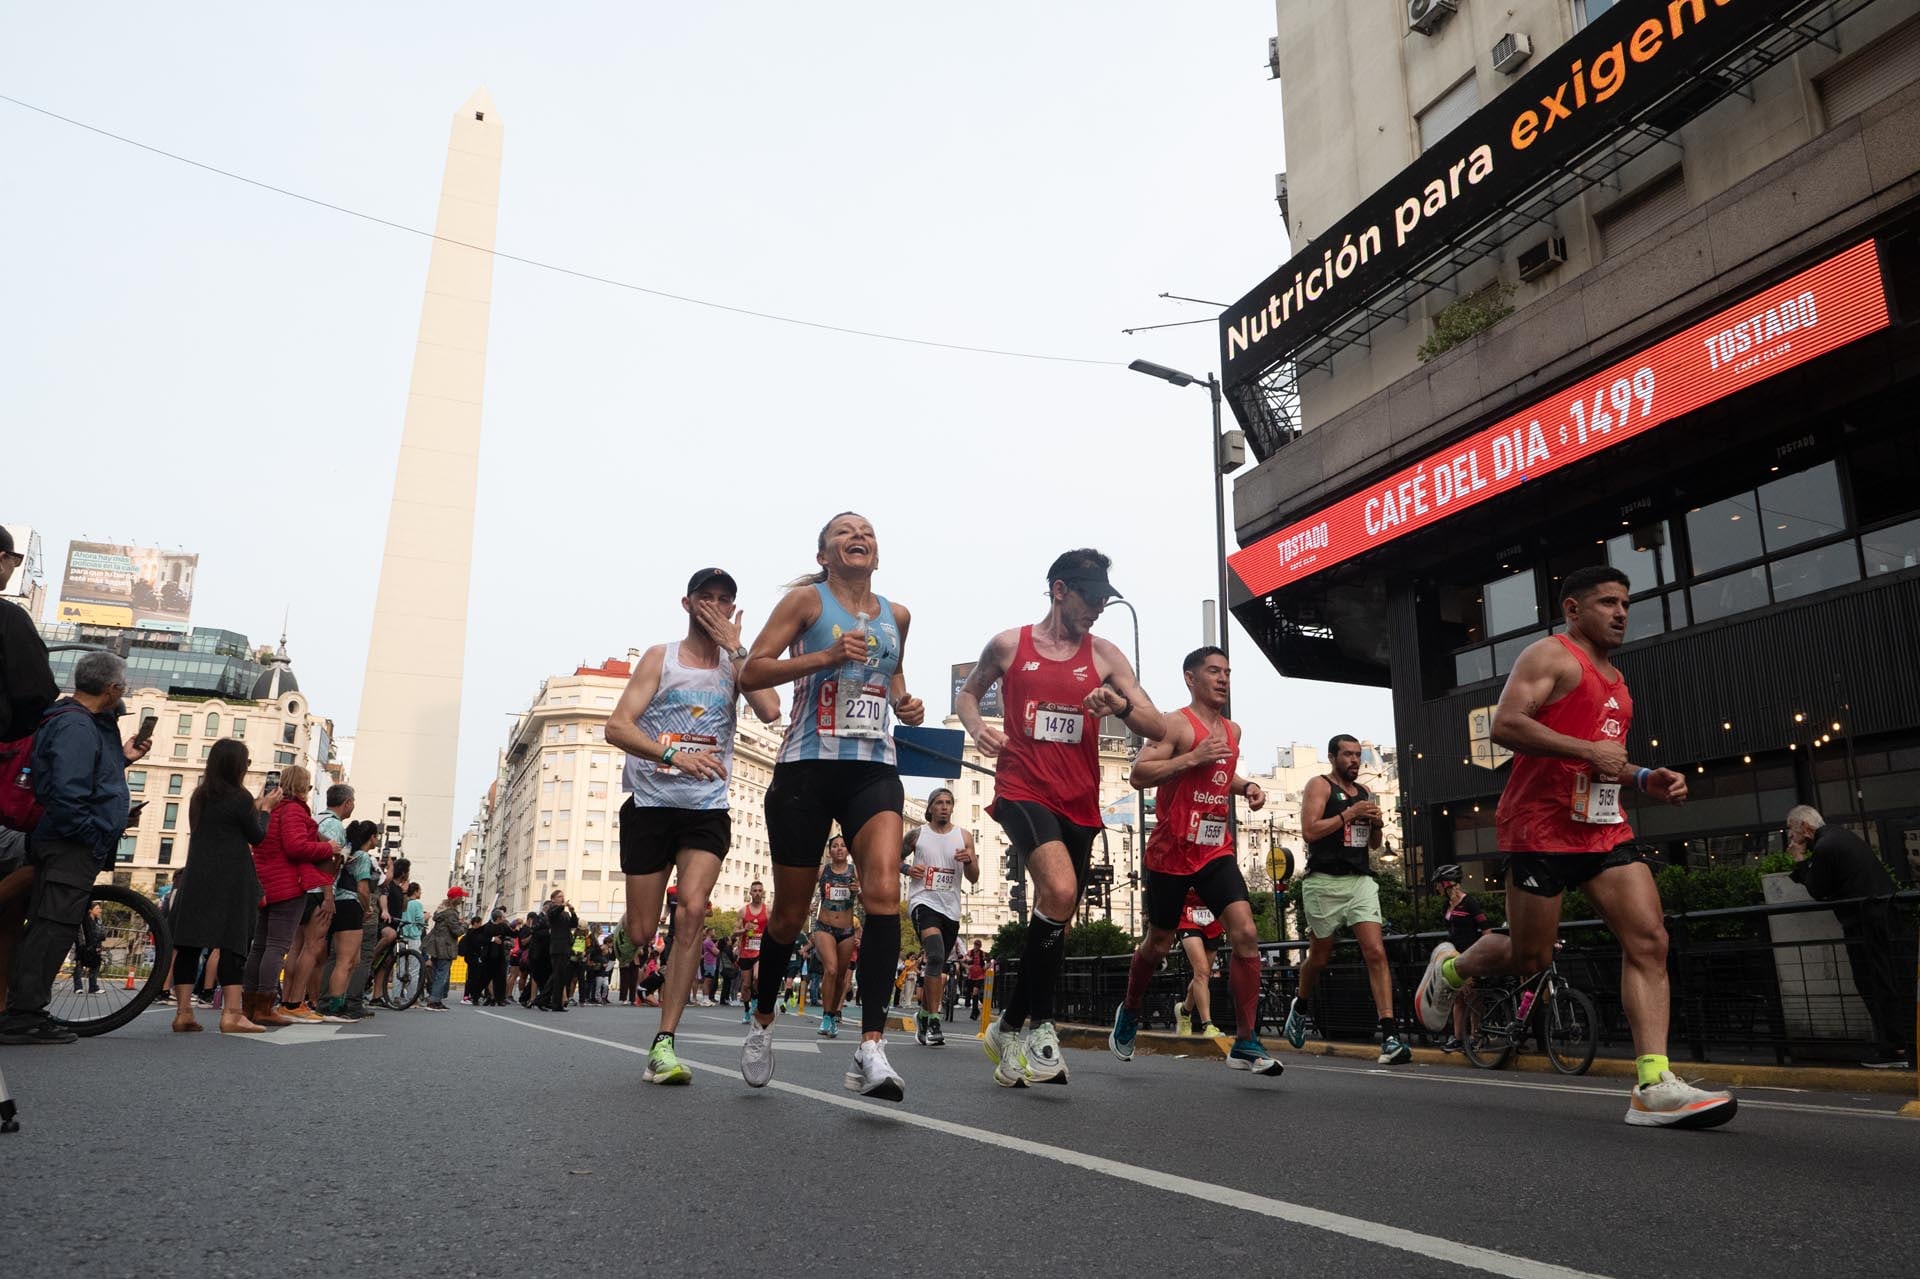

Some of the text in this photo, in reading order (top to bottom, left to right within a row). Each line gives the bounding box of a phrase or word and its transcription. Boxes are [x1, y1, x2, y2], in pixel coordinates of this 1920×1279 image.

[1228, 0, 1731, 360] Nutrición para exigen
[1704, 291, 1818, 371] TOSTADO
[1734, 341, 1792, 374] CAFÉ CLUB
[1364, 465, 1429, 536] CAFÉ
[1433, 450, 1488, 507] DEL
[1491, 418, 1551, 481] DIA
[1277, 521, 1329, 567] TOSTADO
[63, 607, 81, 616] BA
[821, 683, 833, 706] C
[845, 699, 880, 720] 2270
[1025, 701, 1035, 720] C
[1045, 716, 1075, 734] 1478
[1190, 812, 1199, 828] C
[1204, 825, 1222, 839] 1555
